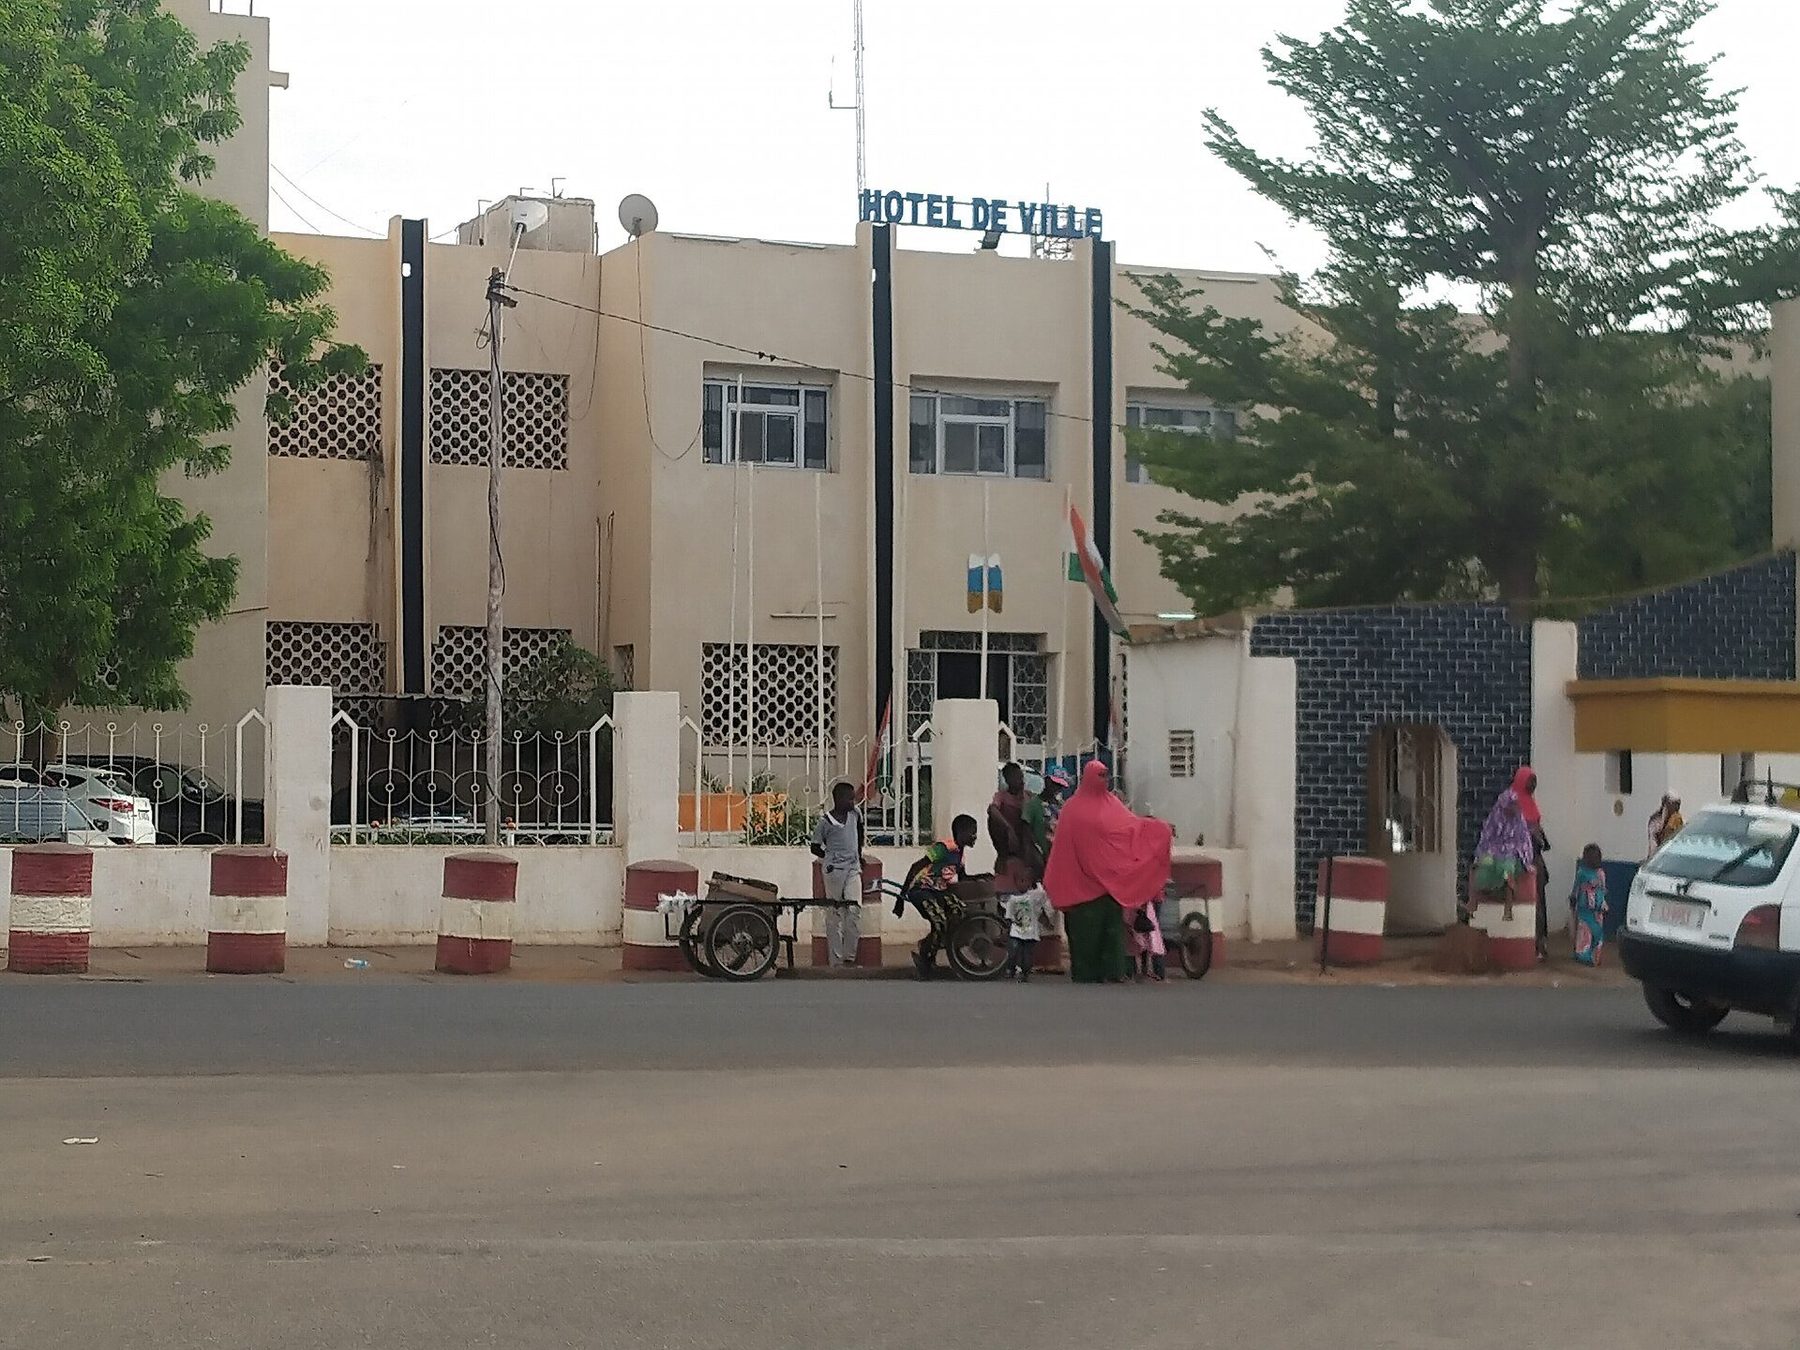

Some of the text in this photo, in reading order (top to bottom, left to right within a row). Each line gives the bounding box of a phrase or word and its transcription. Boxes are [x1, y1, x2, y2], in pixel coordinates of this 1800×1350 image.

[863, 189, 1102, 241] HOTEL DE VILLE
